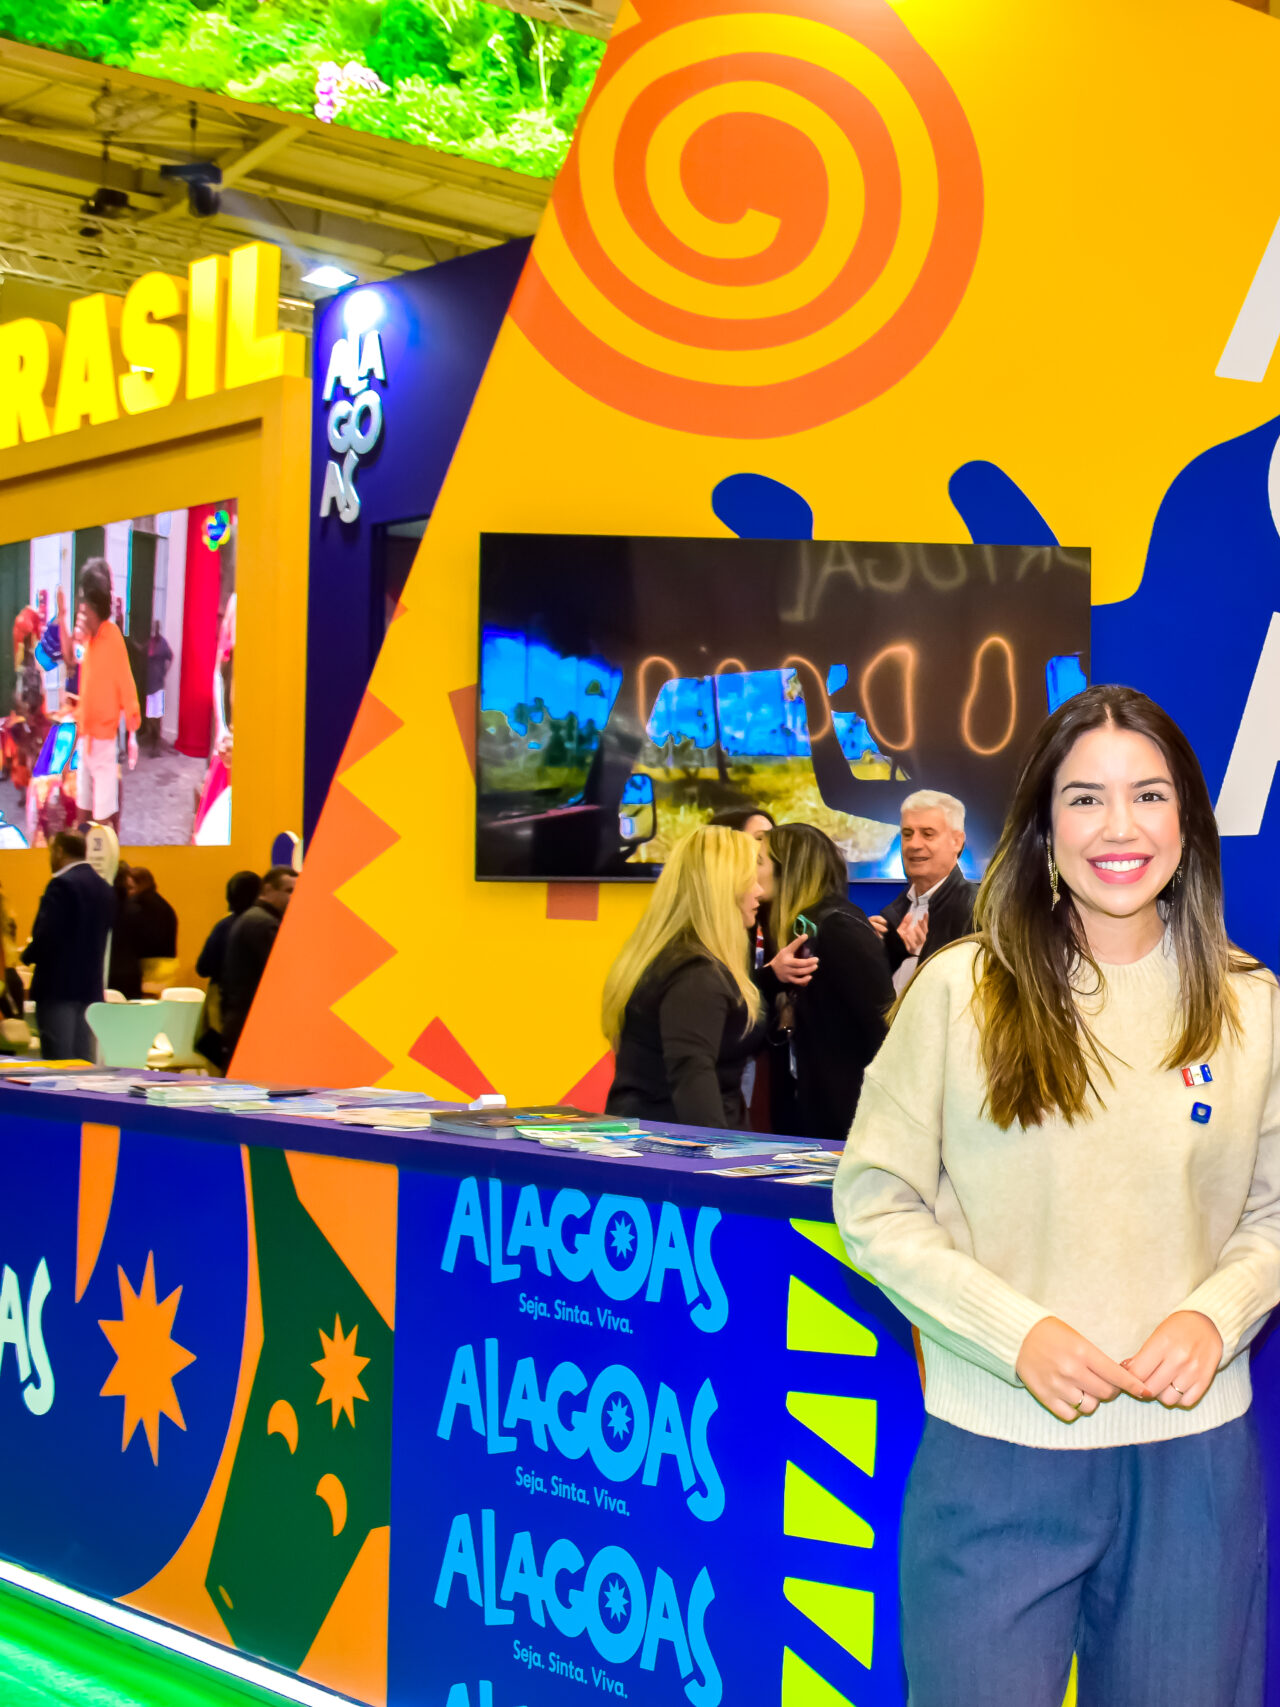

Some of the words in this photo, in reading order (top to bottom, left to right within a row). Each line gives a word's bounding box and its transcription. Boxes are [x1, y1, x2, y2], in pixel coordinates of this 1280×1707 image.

[0, 240, 300, 449] RASIL
[441, 1176, 729, 1333] ALAGOAS
[519, 1293, 551, 1320] Seja.
[553, 1299, 593, 1326] Sinta.
[596, 1307, 634, 1334] Viva.
[437, 1337, 725, 1522] ALAGOAS
[515, 1466, 547, 1495] Seja.
[550, 1475, 590, 1504] Sinta.
[593, 1486, 630, 1517] Viva.
[434, 1509, 723, 1707] ALAGOAS
[513, 1640, 545, 1673] Seja.
[548, 1652, 588, 1685] Sinta.
[591, 1666, 628, 1699] Viva.
